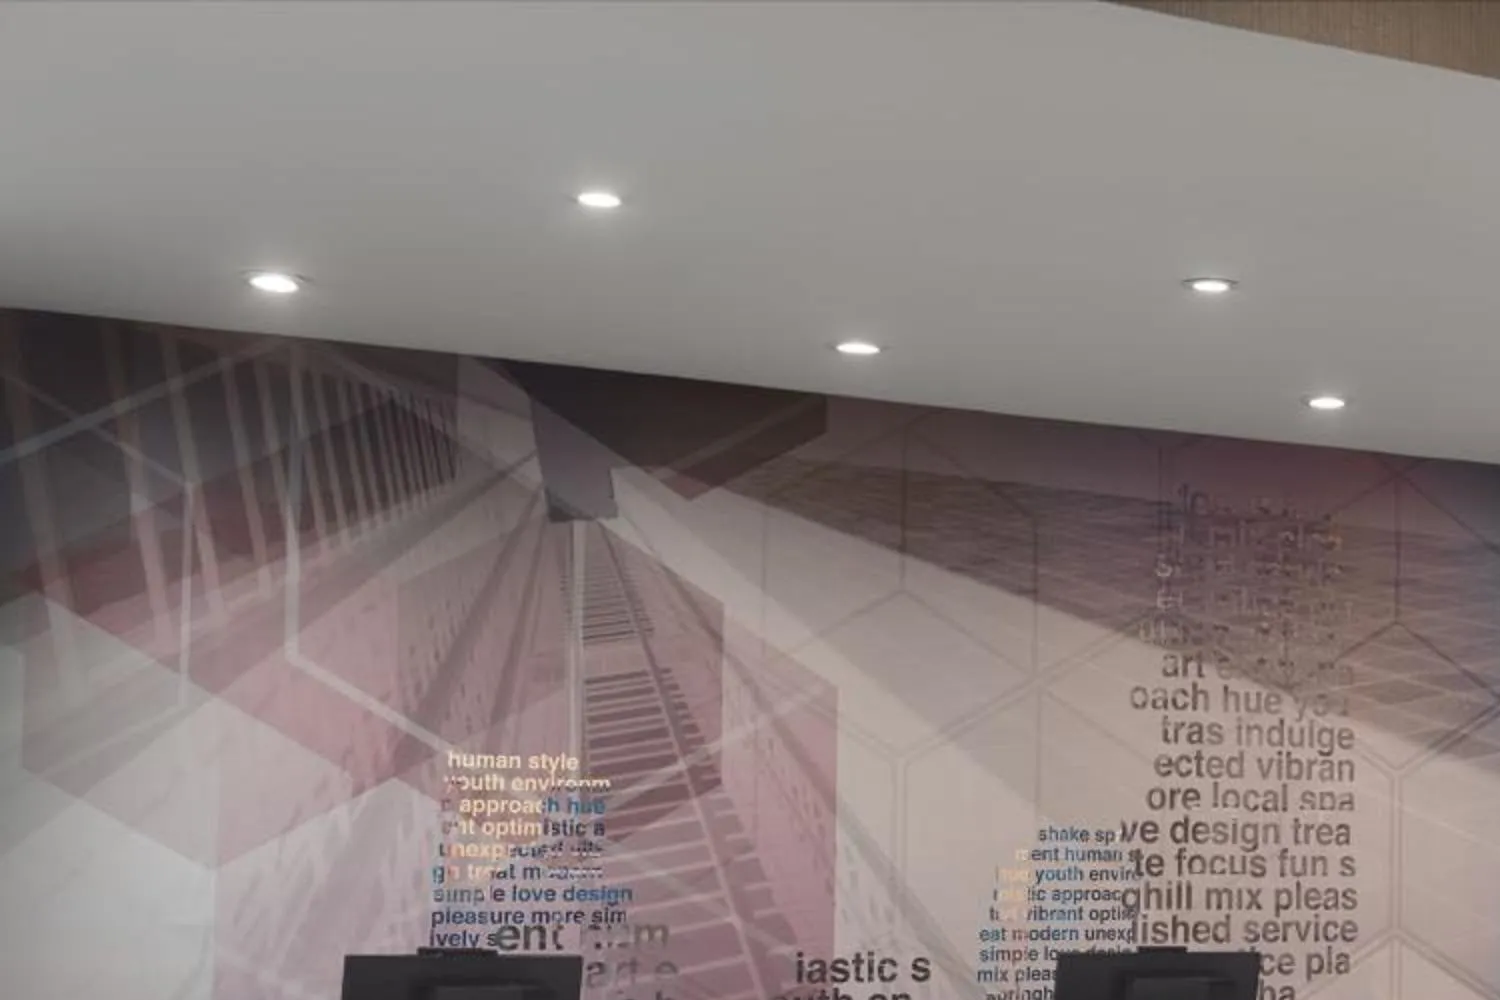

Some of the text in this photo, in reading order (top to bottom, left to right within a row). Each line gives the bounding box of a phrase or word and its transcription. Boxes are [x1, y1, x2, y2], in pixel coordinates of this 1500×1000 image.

[1222, 684, 1283, 714] hue
[1161, 714, 1356, 757] tras indulge
[448, 751, 580, 776] human style
[1153, 750, 1356, 783] ected vibran
[1146, 785, 1201, 811] ore
[1211, 781, 1289, 813] local
[481, 818, 587, 839] optimistic
[1038, 826, 1090, 844] shake
[1168, 814, 1282, 853] design
[1293, 817, 1351, 846] trea
[1036, 866, 1083, 885] youth
[1174, 847, 1268, 878] focus
[1277, 848, 1328, 878] fun
[1338, 855, 1357, 878] s
[512, 884, 556, 901] love
[563, 882, 633, 907] design
[1204, 886, 1263, 912] mix
[1273, 881, 1358, 918] pleas
[431, 909, 526, 930] pleasure
[531, 912, 585, 926] more
[1243, 914, 1359, 944] service
[979, 928, 1006, 941] eat
[911, 957, 931, 982] s
[977, 967, 1009, 982] mix
[1304, 946, 1351, 982] pla
